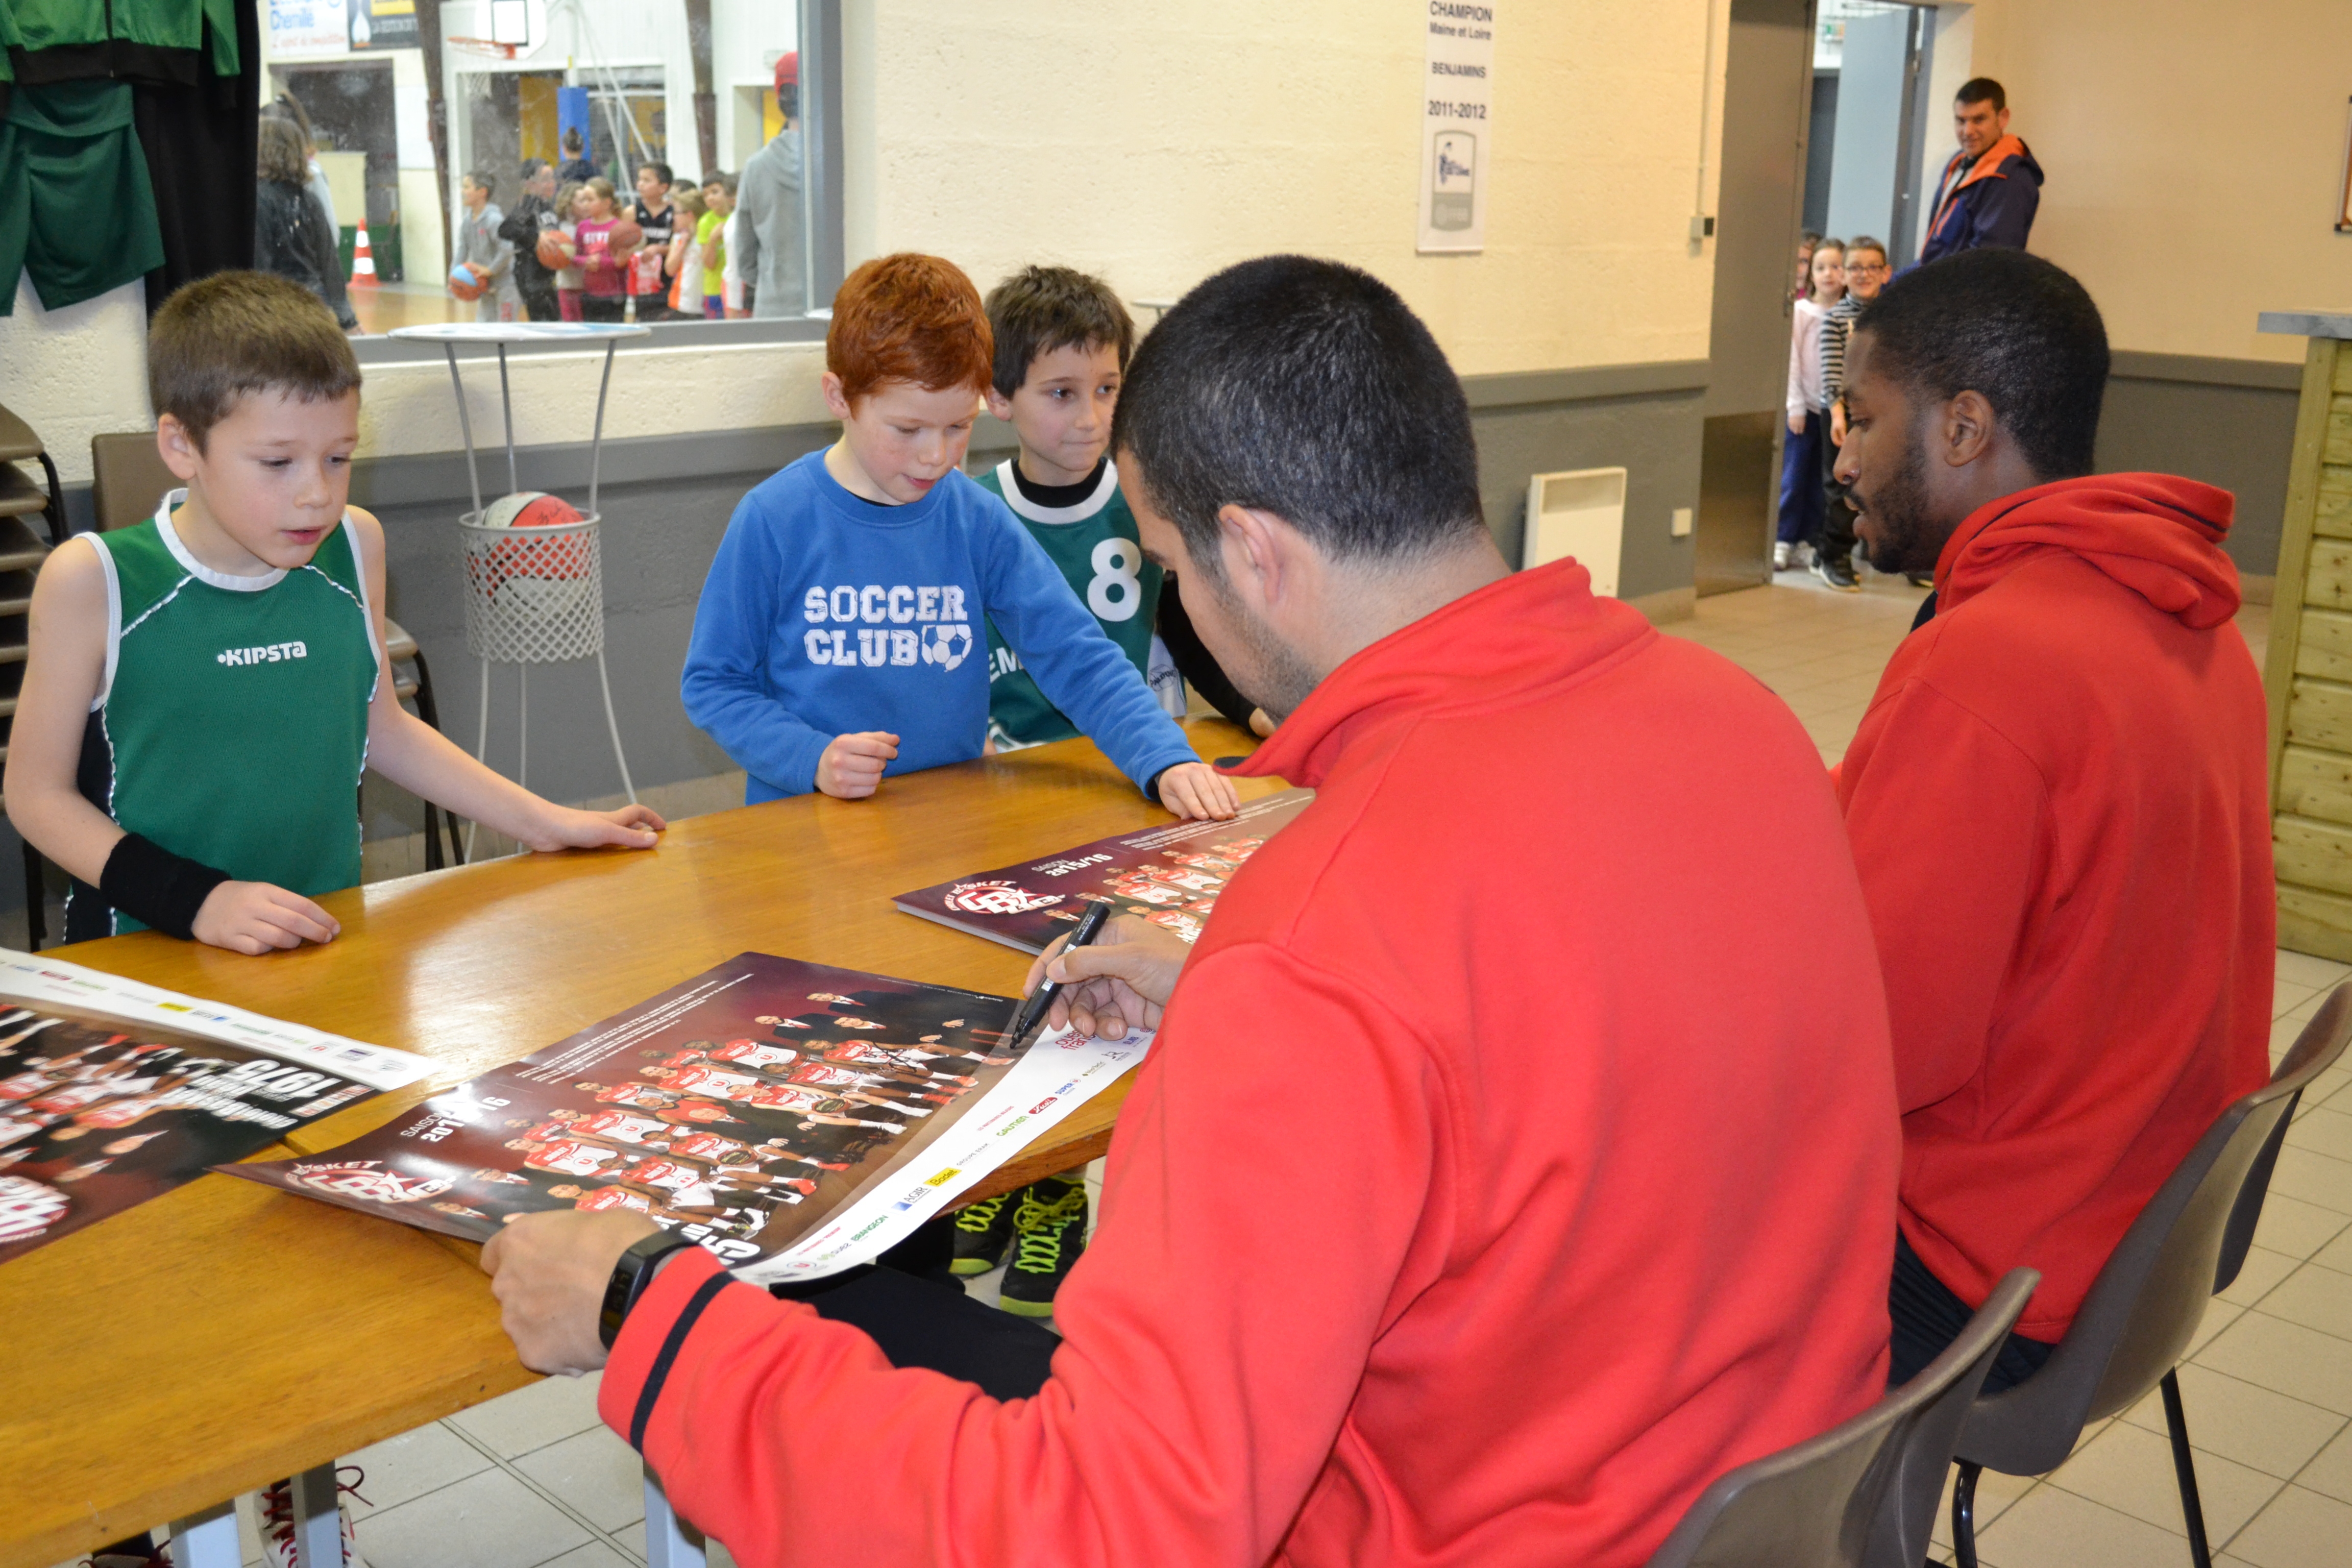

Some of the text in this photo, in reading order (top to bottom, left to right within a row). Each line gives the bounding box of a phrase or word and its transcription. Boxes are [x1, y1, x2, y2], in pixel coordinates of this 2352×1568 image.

[1429, 1, 1492, 21] CHAMPION
[1429, 22, 1491, 40] Maine et Loire
[1432, 61, 1486, 78] BENJAMINS
[1428, 100, 1486, 119] 2011-2012
[1087, 537, 1142, 622] 8
[804, 585, 968, 623] SOCCER
[226, 641, 307, 667] KIPSTA
[804, 629, 918, 667] CLUB
[1045, 853, 1114, 876] 2015/16
[223, 1059, 343, 1098] 1975
[1055, 1083, 1074, 1094] SUPER
[400, 1110, 443, 1138] SAISO
[957, 1142, 990, 1166] GROUPE ERAM
[929, 1169, 958, 1186] Bodet
[903, 1186, 929, 1202] AGIR
[850, 1214, 889, 1241] BRANGEON
